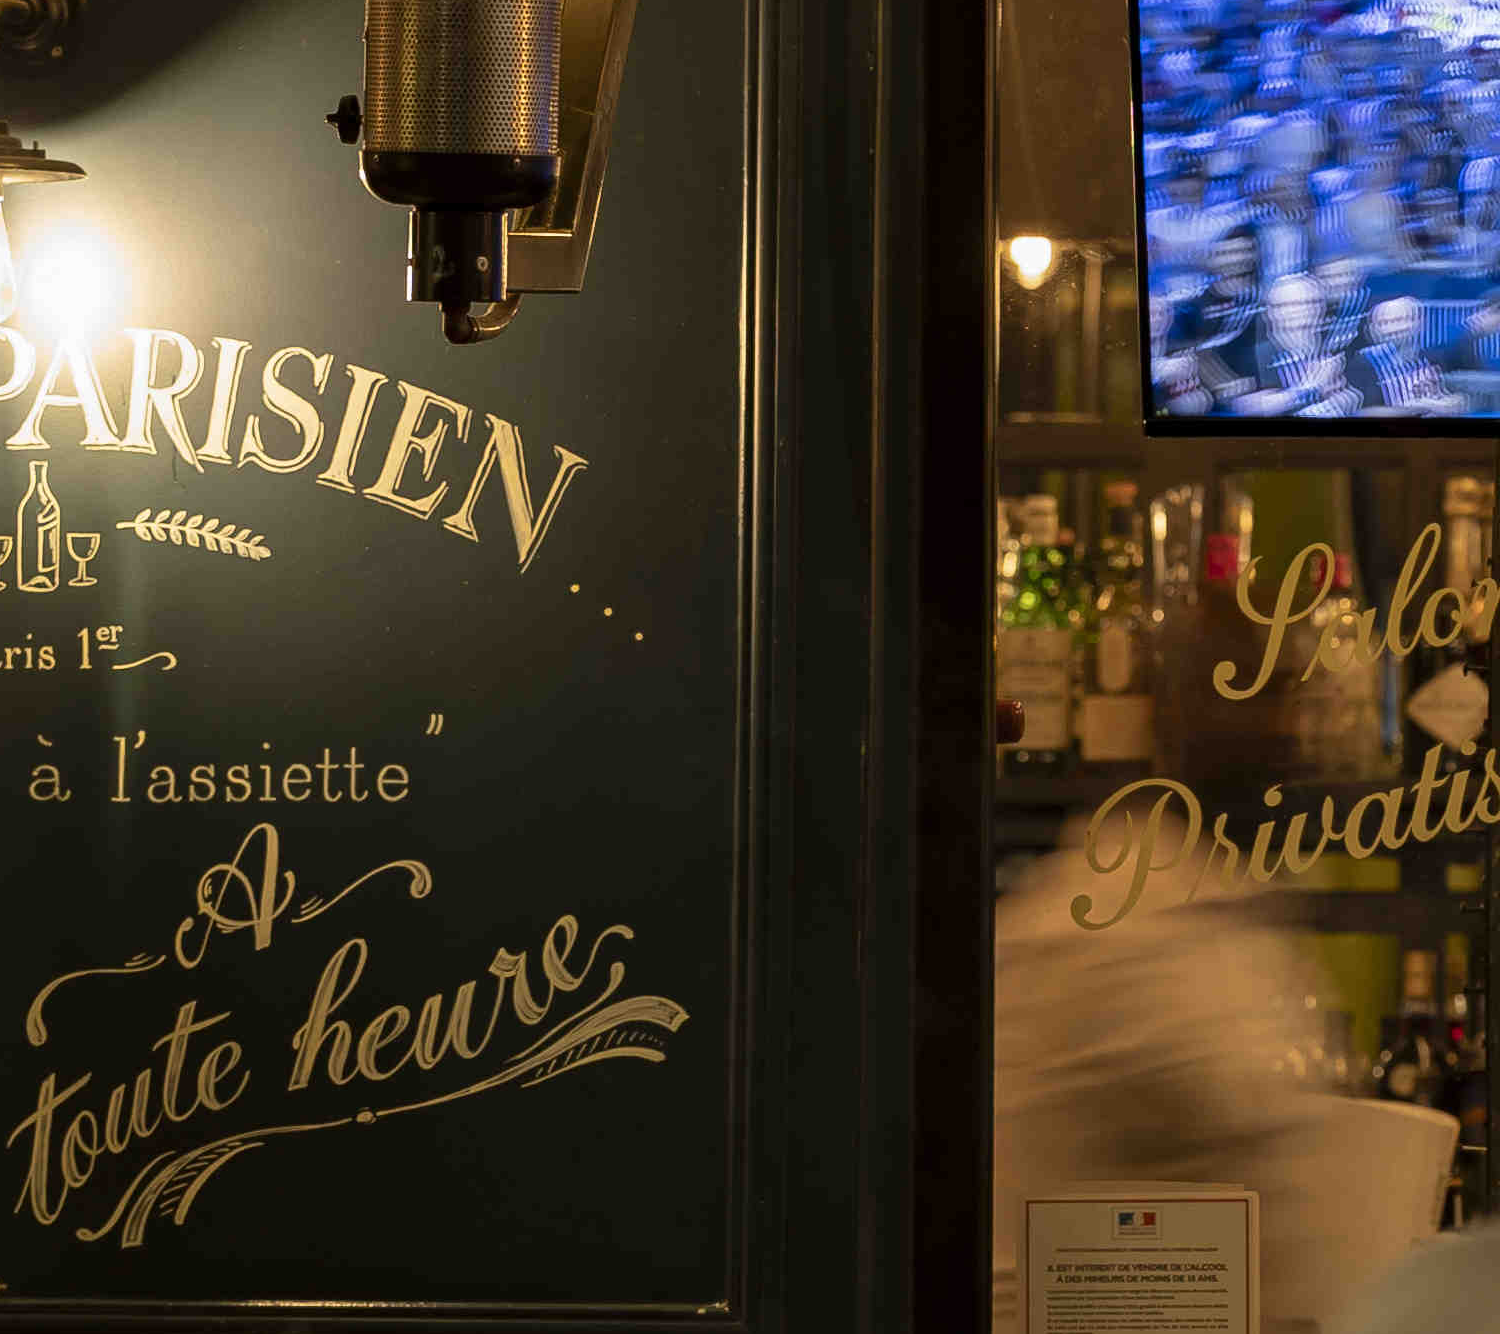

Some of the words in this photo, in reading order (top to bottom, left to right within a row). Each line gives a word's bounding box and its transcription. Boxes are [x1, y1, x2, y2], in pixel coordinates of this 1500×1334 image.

[30, 736, 71, 805] à
[174, 822, 295, 970] A
[5, 1000, 252, 1225] toute
[285, 913, 636, 1095] heure
